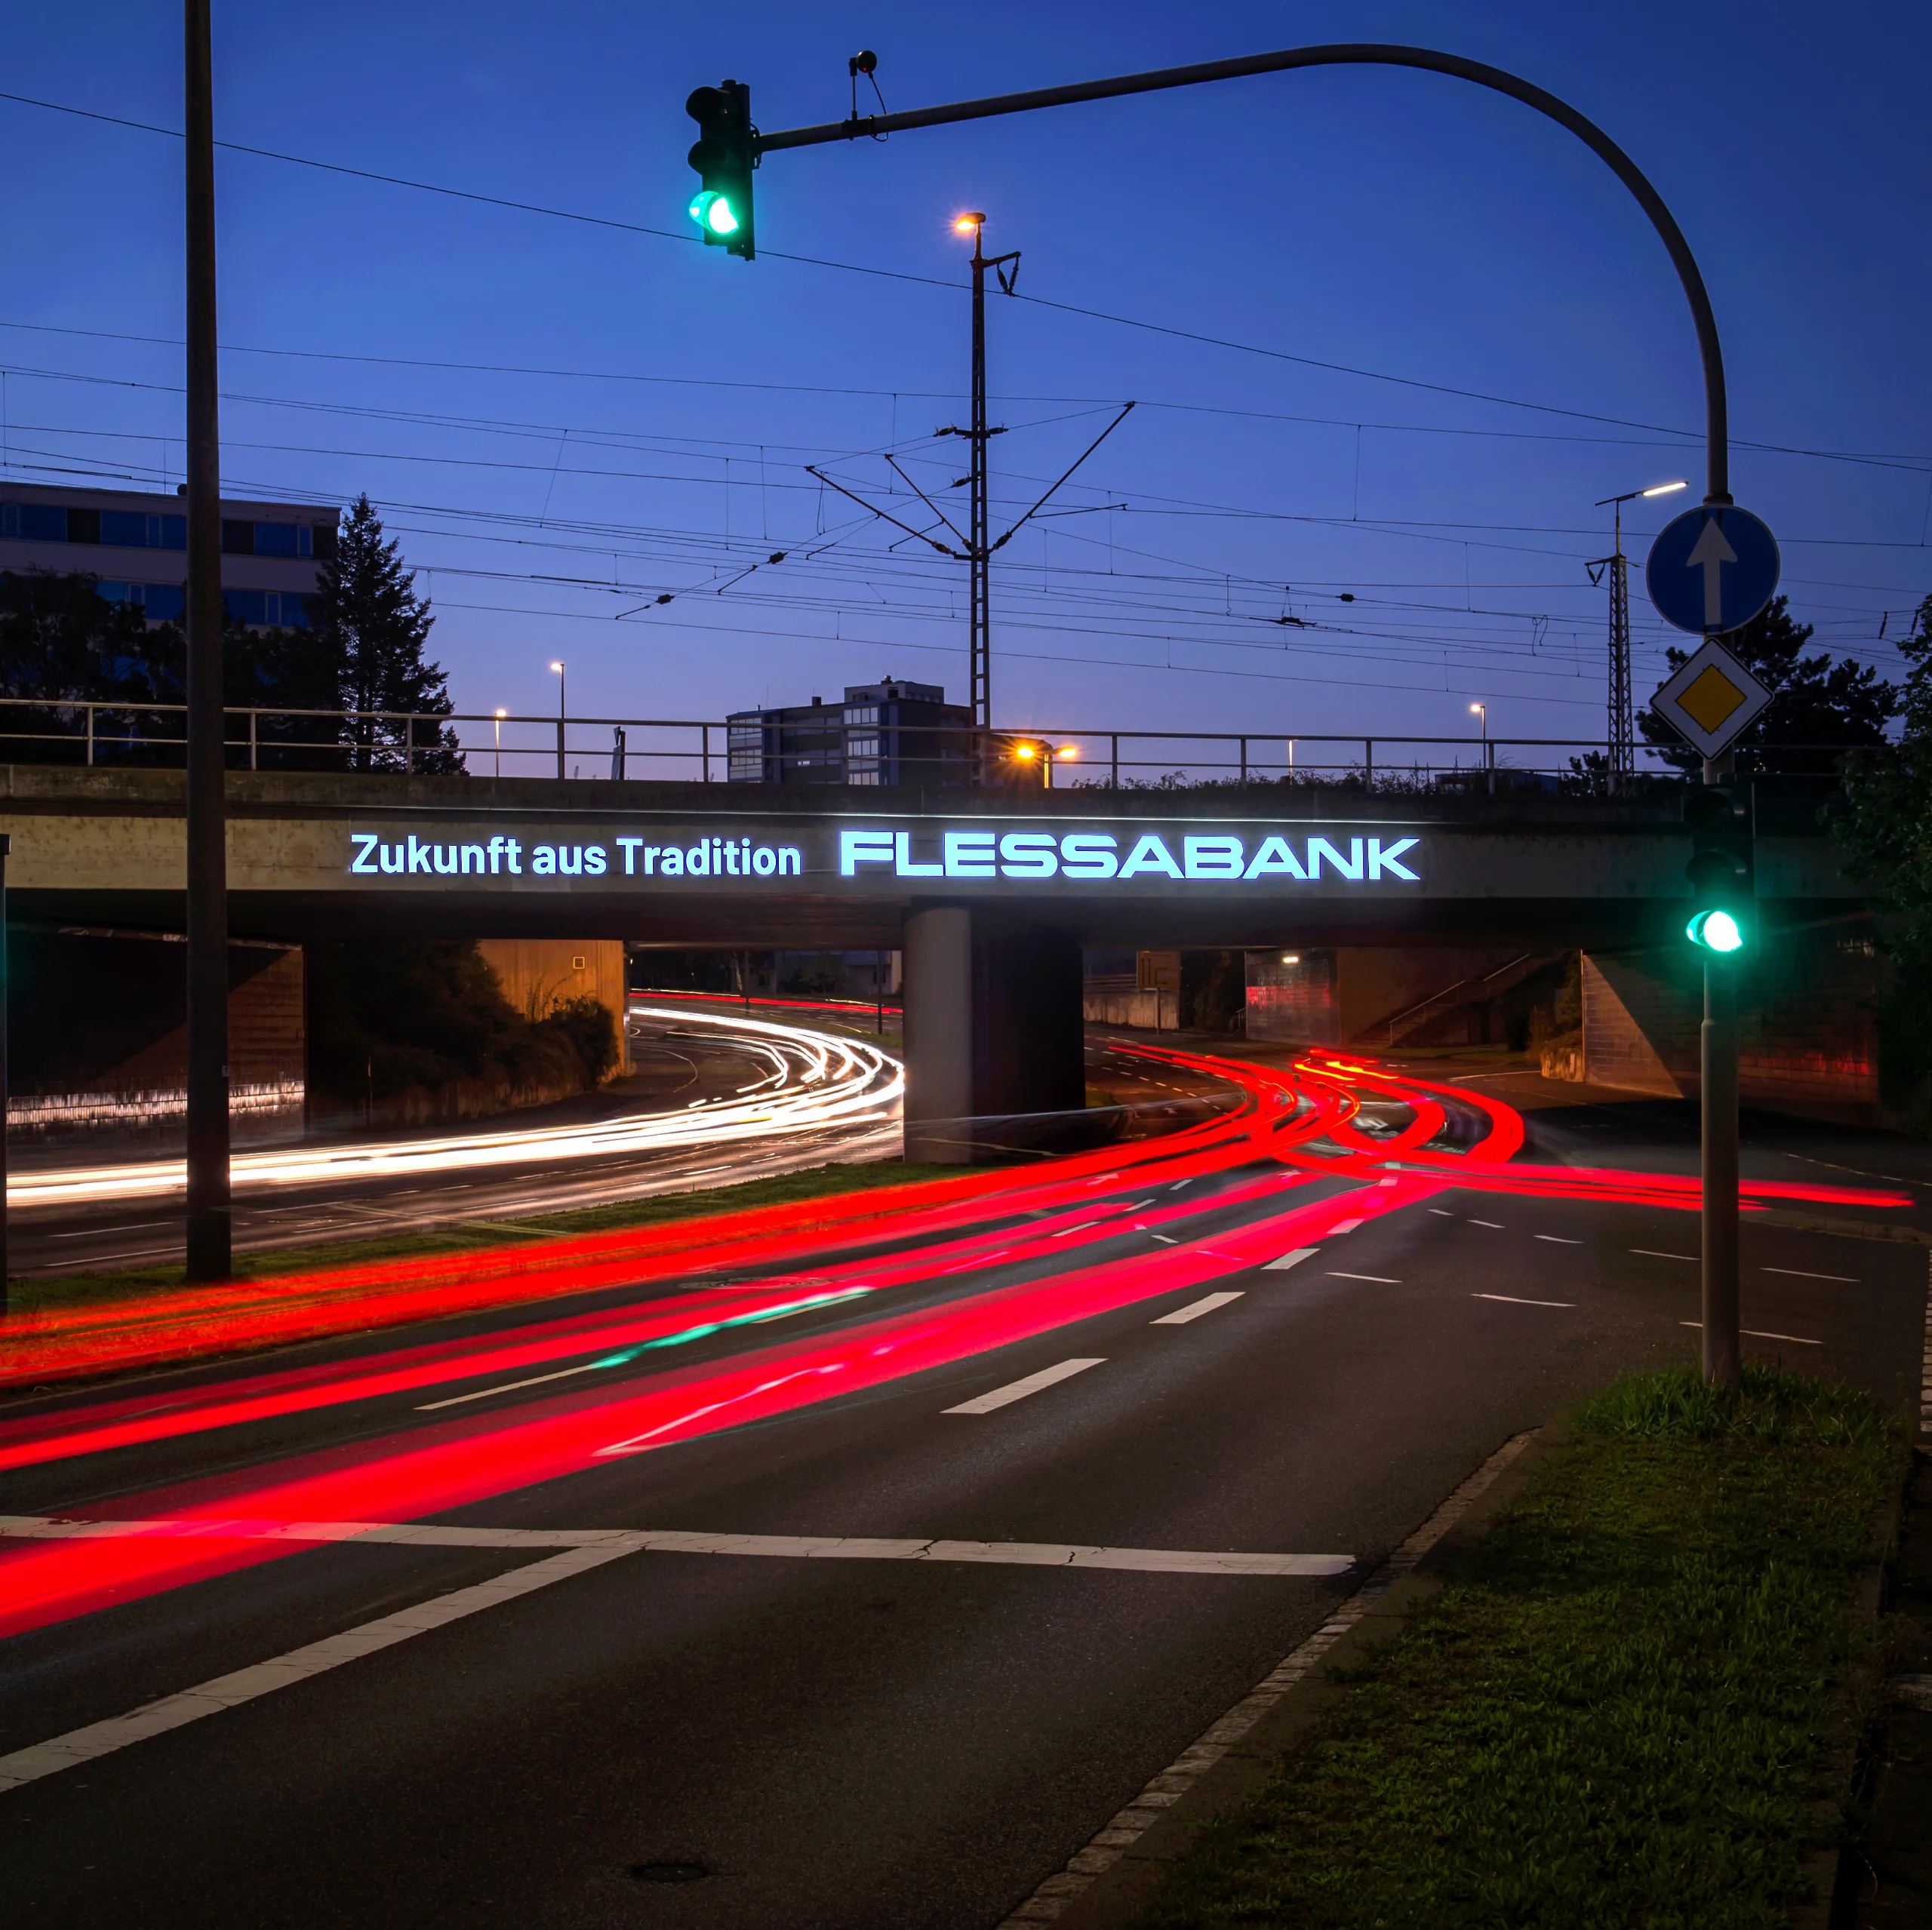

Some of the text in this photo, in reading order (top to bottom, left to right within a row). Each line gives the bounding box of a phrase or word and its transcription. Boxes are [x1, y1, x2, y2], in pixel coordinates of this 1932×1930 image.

[350, 834, 801, 876] Zukunft aus Tradition
[839, 830, 1421, 881] FLESSABANK
